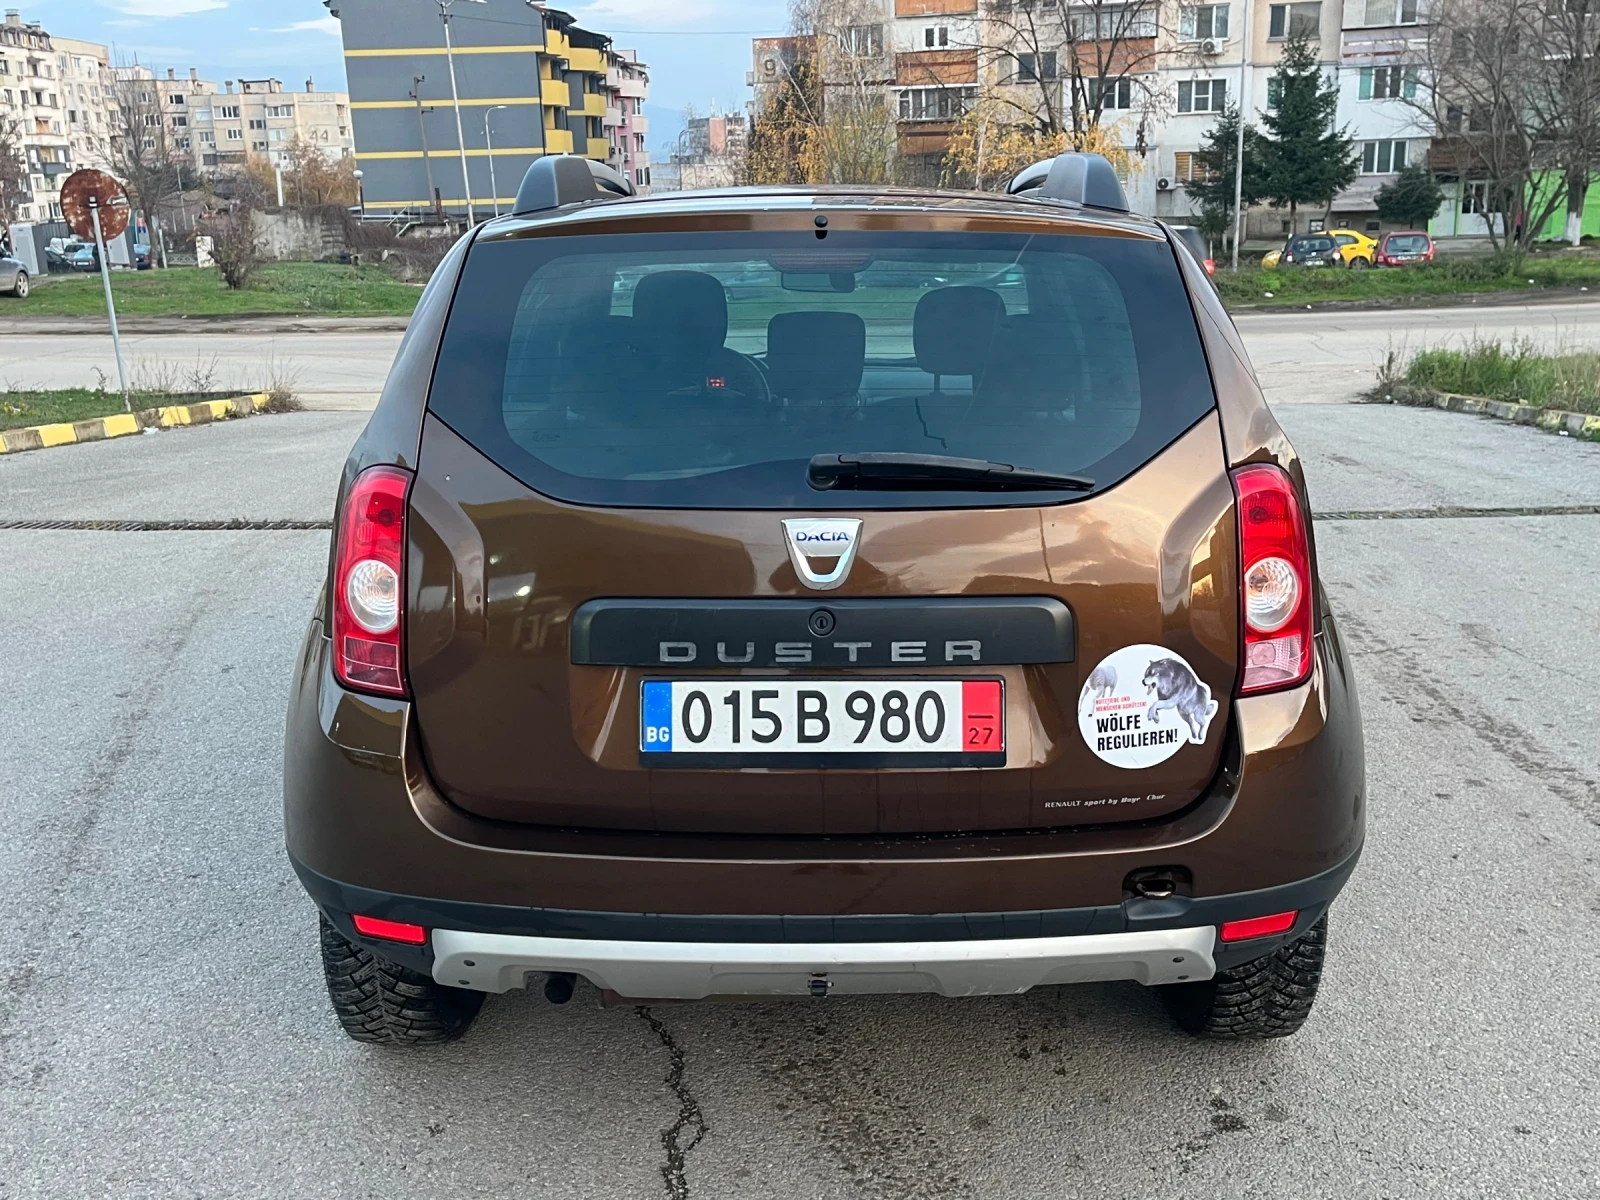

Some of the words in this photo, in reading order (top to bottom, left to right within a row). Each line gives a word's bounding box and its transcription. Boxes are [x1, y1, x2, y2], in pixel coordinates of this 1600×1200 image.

[764, 59, 777, 77] 9
[796, 531, 849, 542] DACIA
[659, 640, 982, 663] DUSTER
[1096, 713, 1141, 733] WÖLFE
[646, 727, 670, 743] BG
[969, 727, 994, 745] 27
[1097, 728, 1178, 751] REGULIEREN!
[1044, 800, 1081, 808] RENAULT
[1083, 799, 1106, 807] sport
